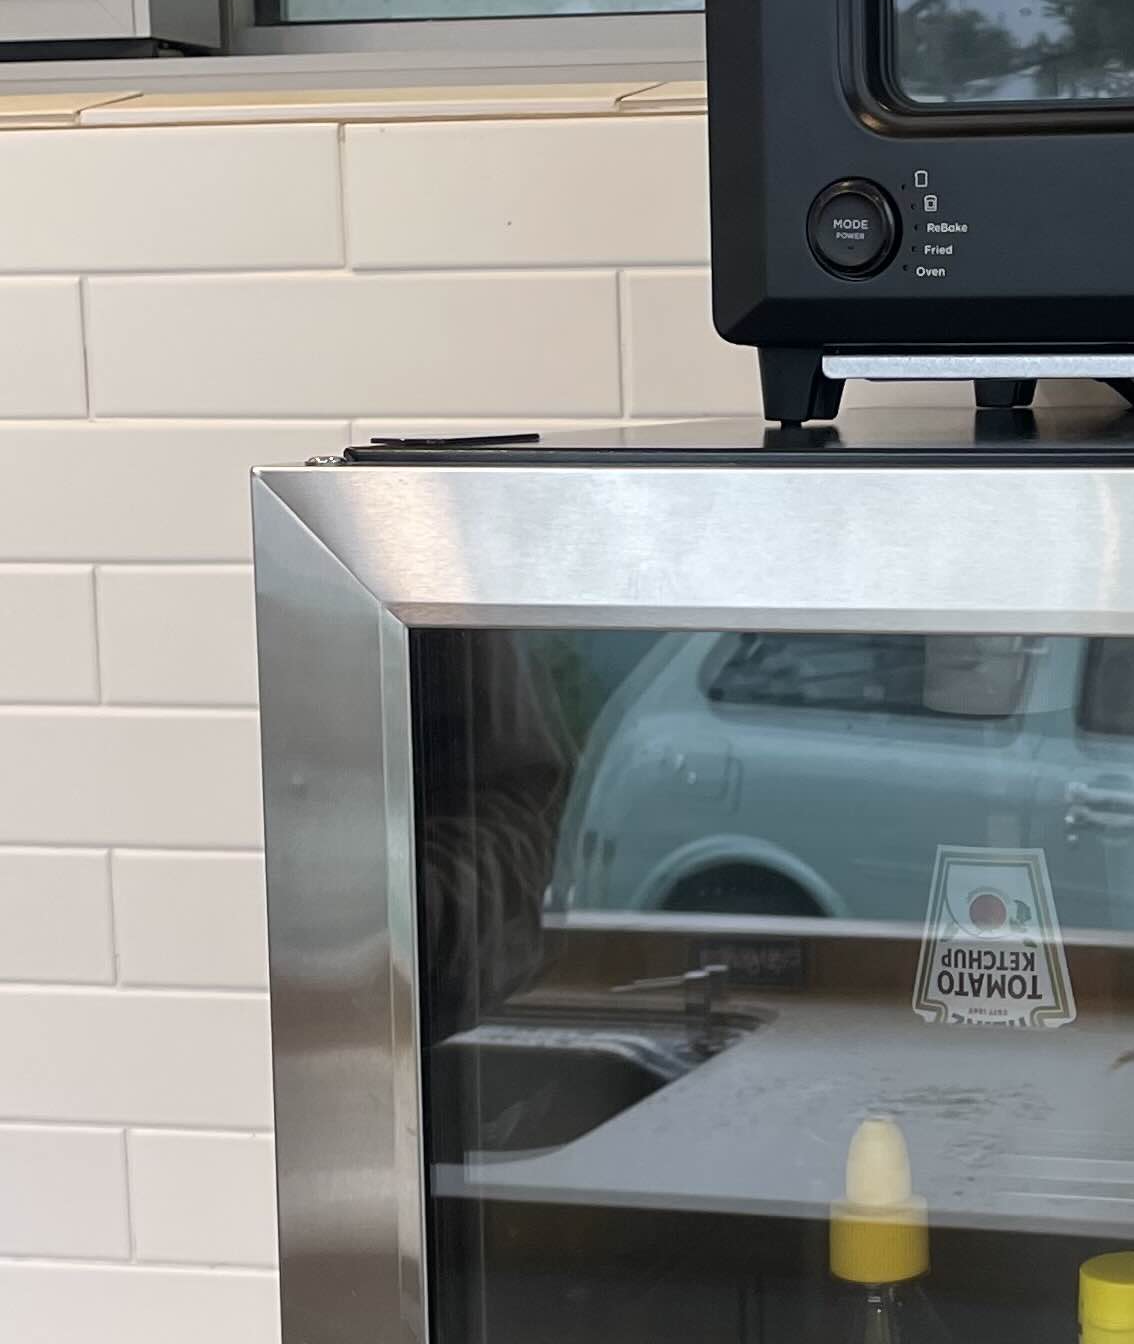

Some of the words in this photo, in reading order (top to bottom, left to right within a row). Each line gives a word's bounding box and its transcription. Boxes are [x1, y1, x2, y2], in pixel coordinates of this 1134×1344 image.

[833, 218, 869, 230] MODE
[926, 221, 968, 234] ReBake
[836, 231, 865, 240] POWER
[924, 244, 953, 256] Fried
[916, 266, 946, 277] Oven
[941, 948, 1036, 972] KETCHUP
[937, 970, 1043, 1000] TOMATO
